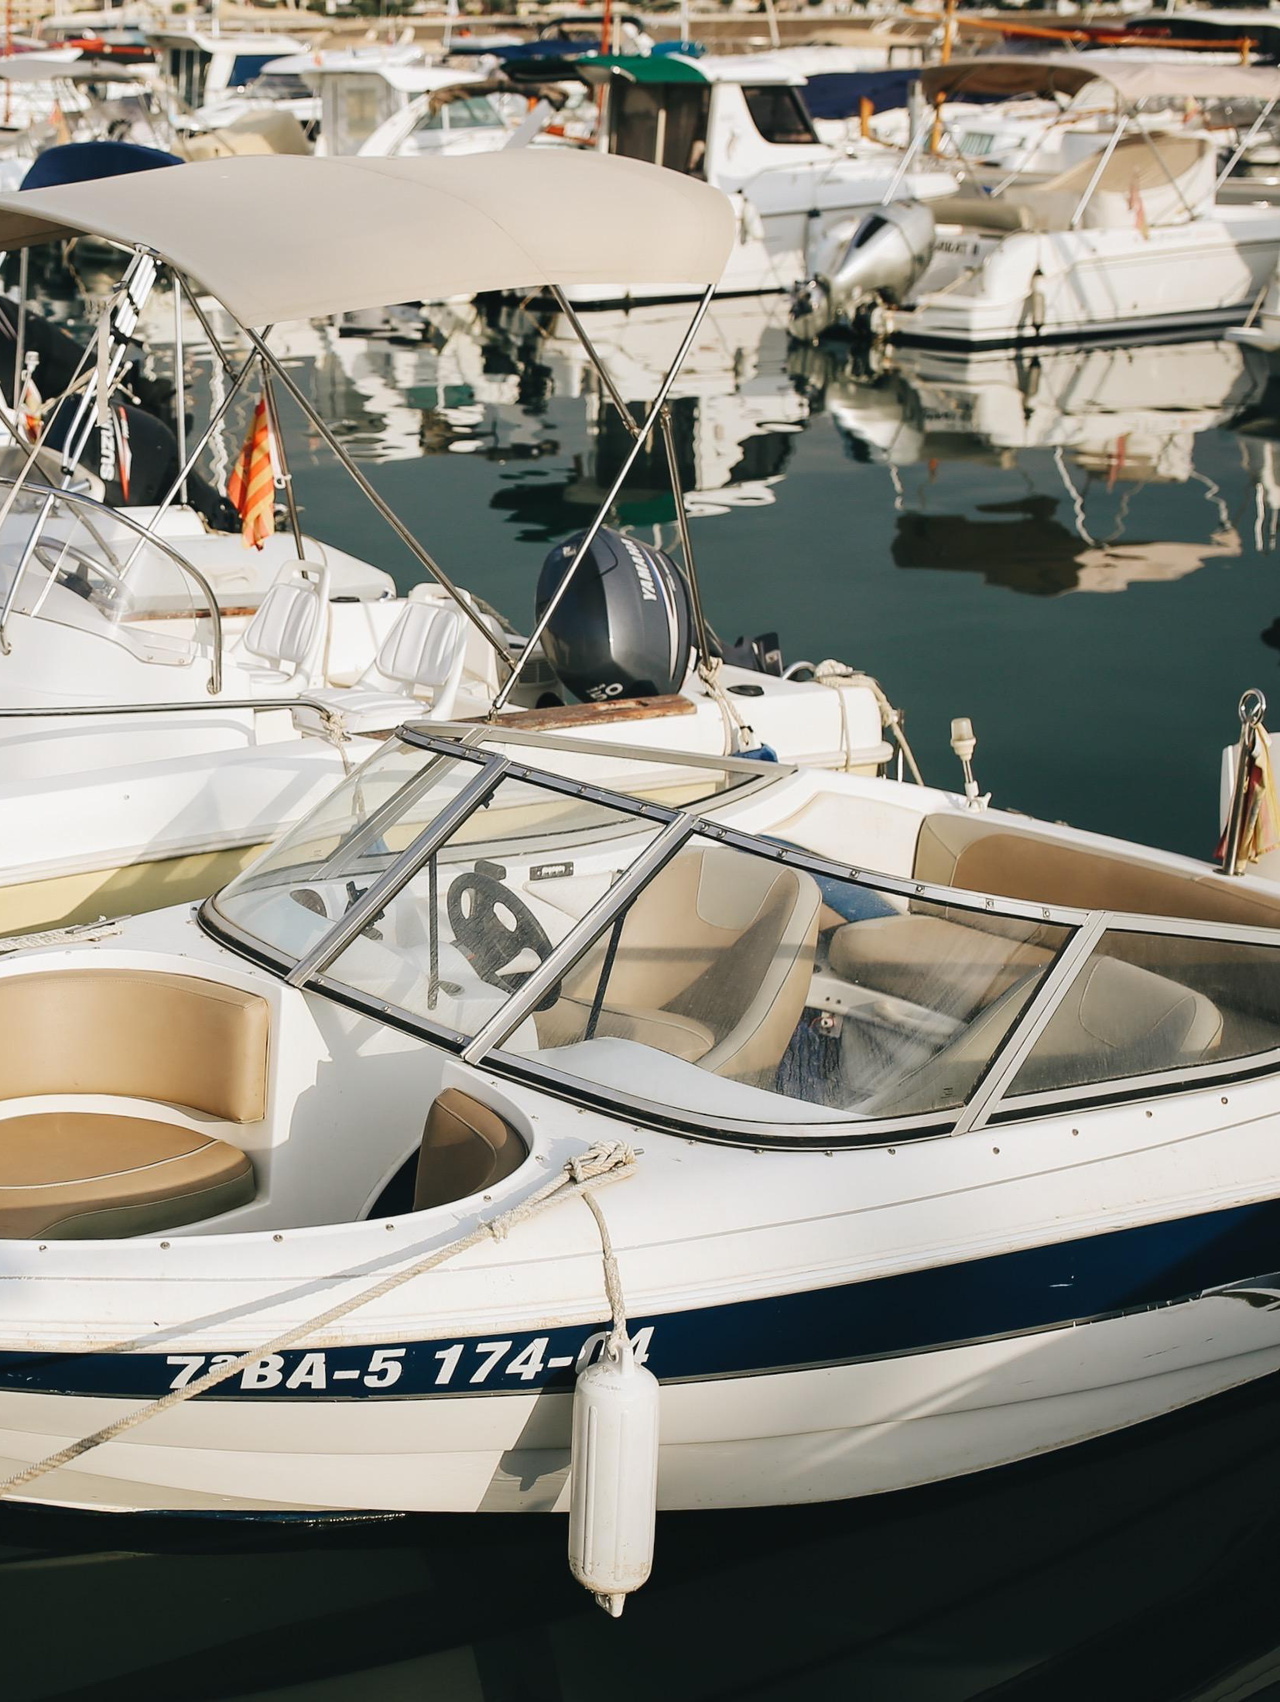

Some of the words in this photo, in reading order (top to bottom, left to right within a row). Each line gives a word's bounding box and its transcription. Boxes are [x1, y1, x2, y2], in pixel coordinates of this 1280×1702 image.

[99, 408, 116, 482] SUZU
[621, 537, 658, 601] YAMAHA
[589, 682, 624, 702] 50
